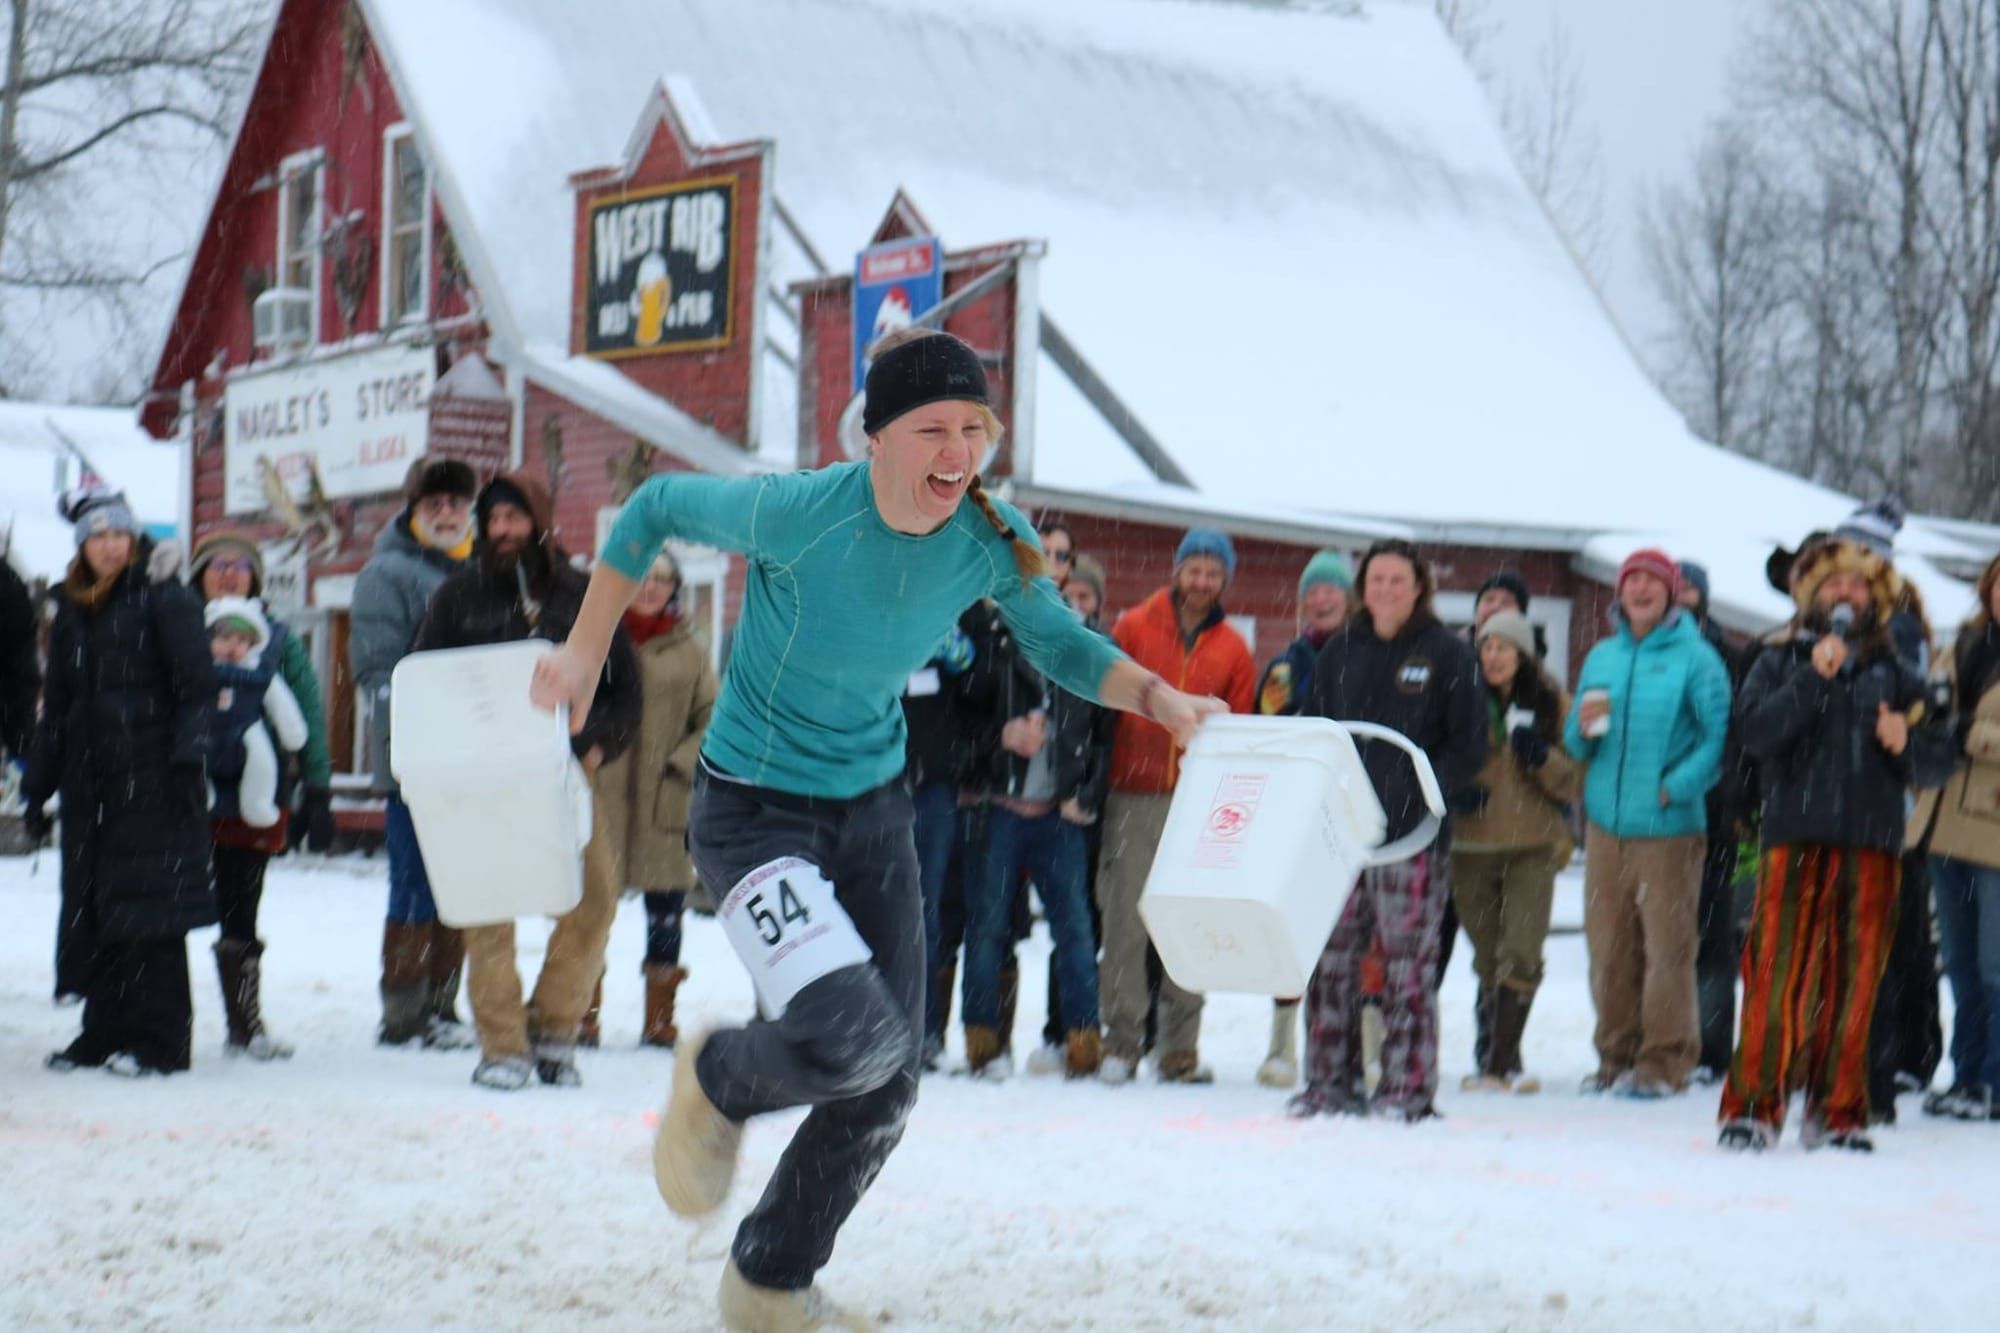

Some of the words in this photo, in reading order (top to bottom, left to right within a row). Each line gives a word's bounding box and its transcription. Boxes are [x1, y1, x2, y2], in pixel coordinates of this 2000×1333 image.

[595, 199, 669, 287] WEST
[671, 190, 725, 273] RIB
[237, 386, 330, 445] NAGLEY'S
[357, 372, 427, 421] STORE
[746, 878, 810, 946] 54
